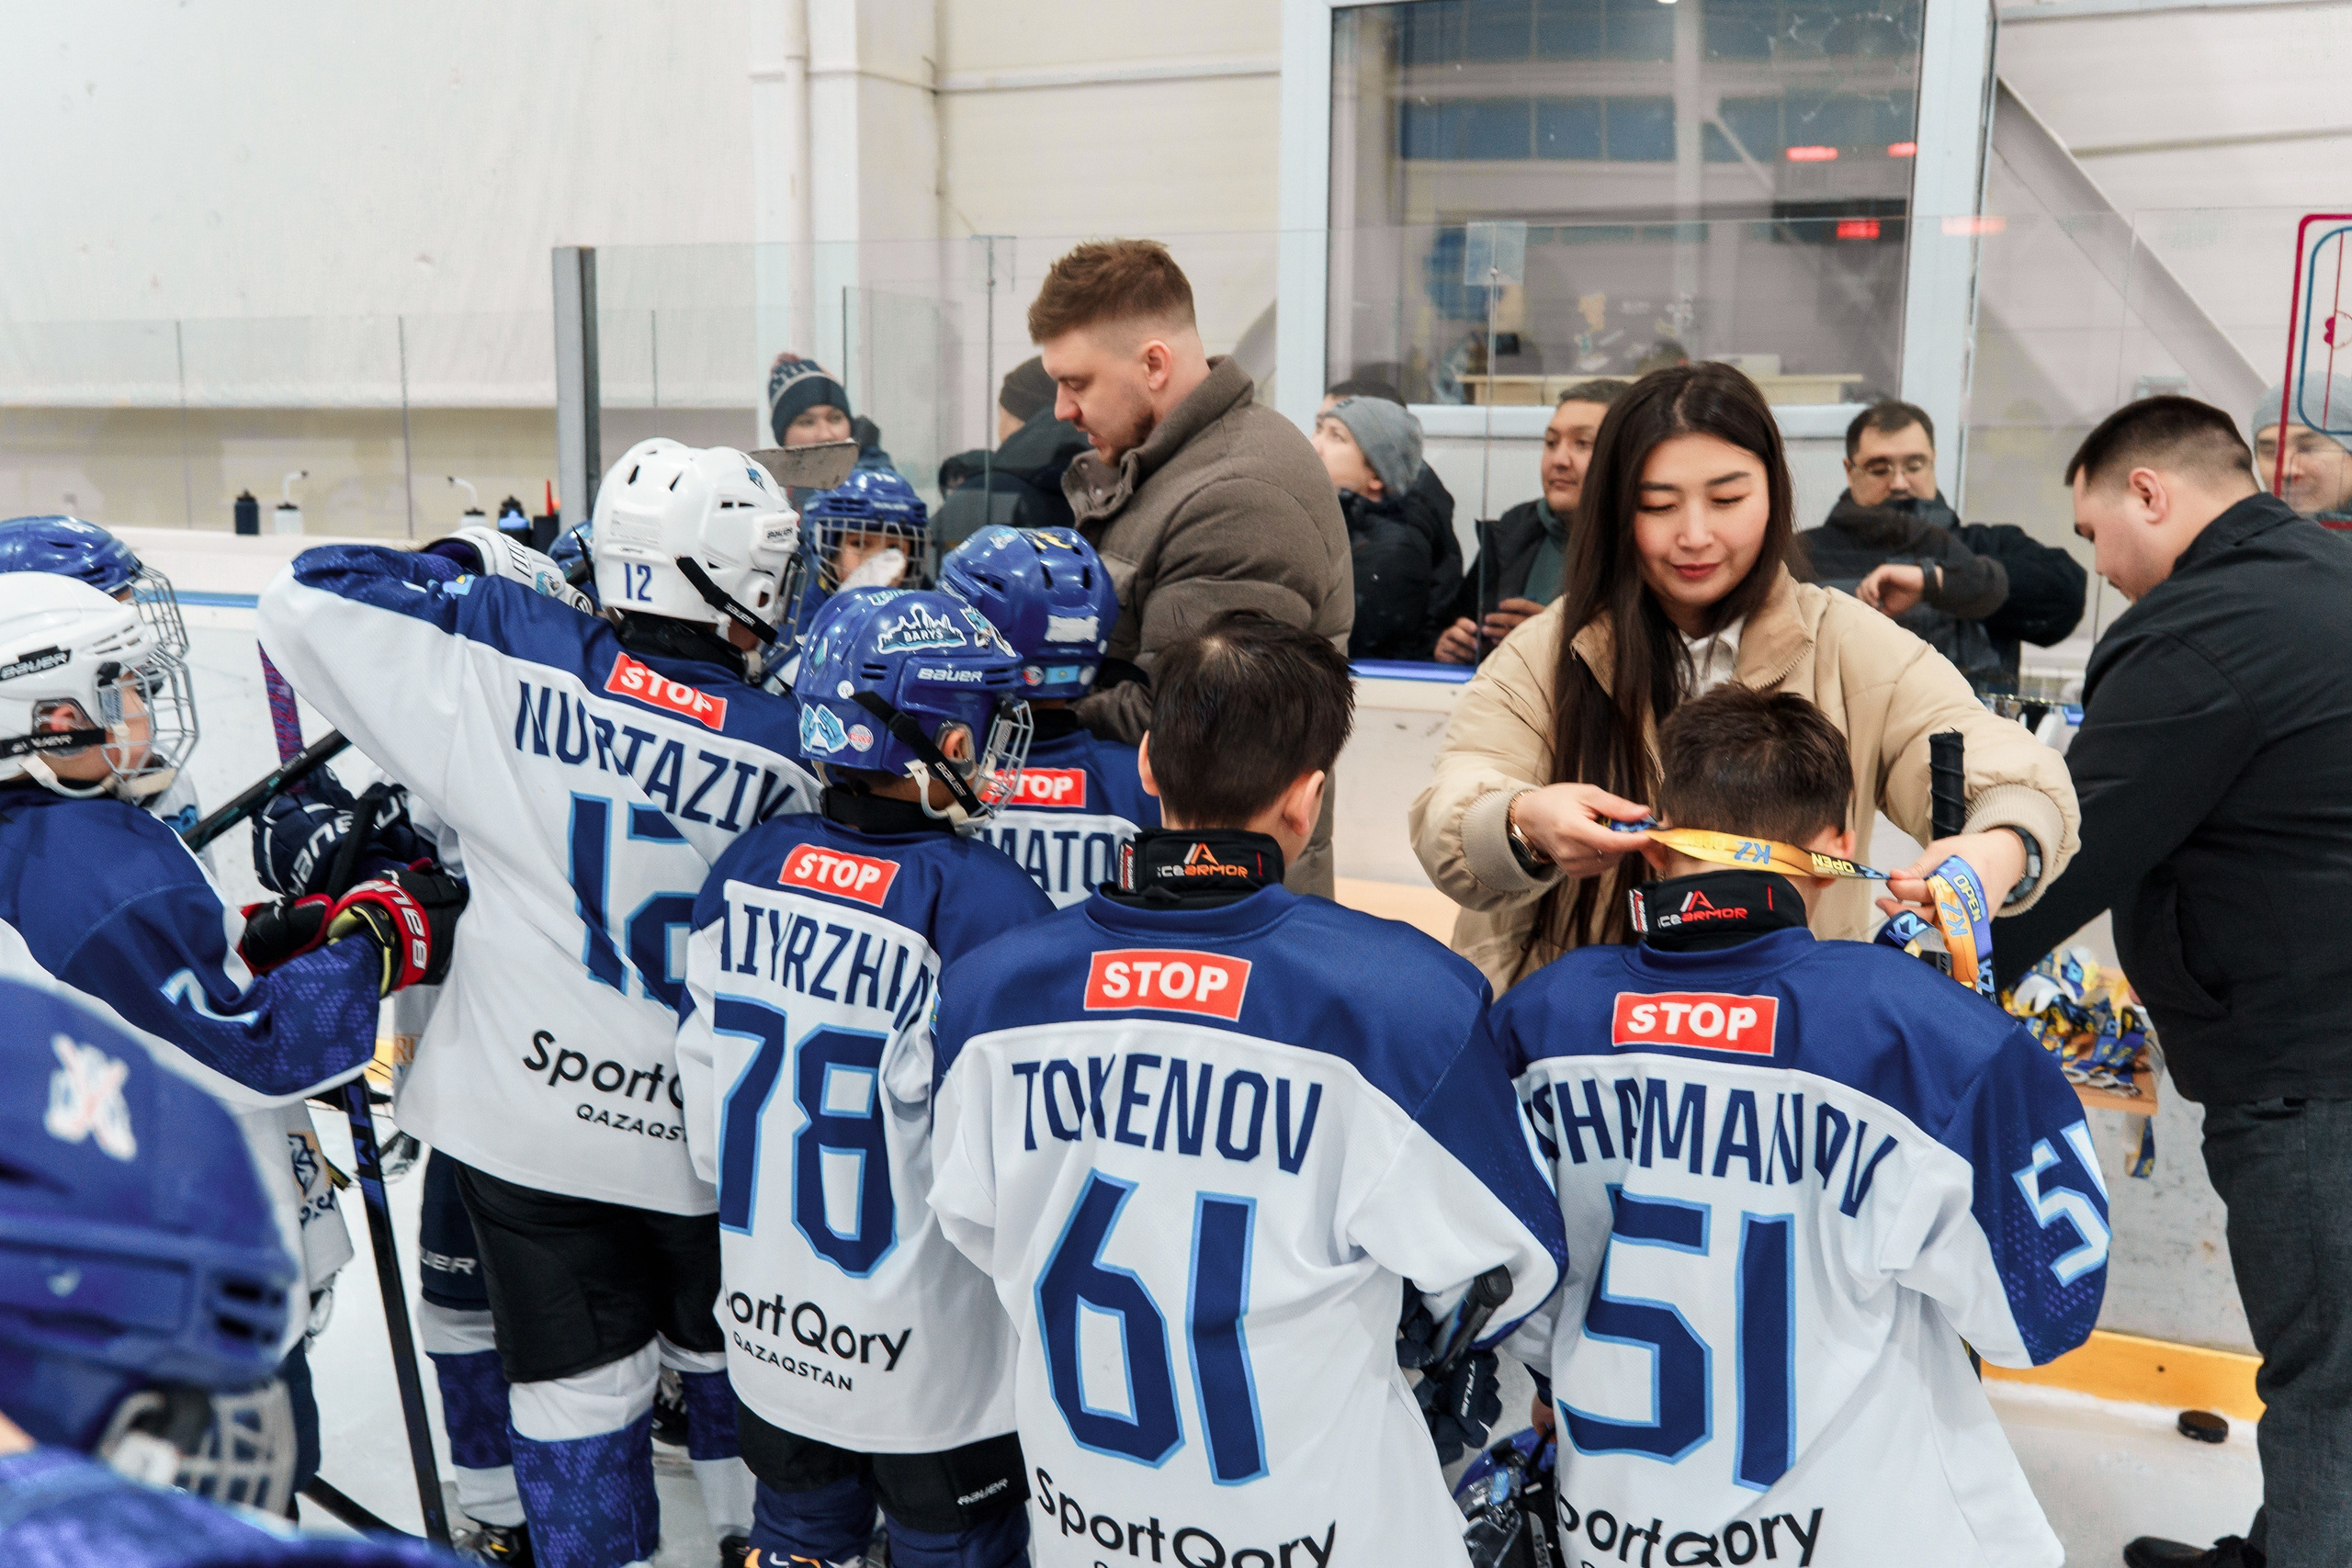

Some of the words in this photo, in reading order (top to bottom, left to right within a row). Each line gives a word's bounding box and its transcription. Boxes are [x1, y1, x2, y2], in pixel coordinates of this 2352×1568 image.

[624, 562, 652, 602] 12
[903, 628, 944, 642] BARYS
[620, 667, 713, 714] STOP
[288, 809, 356, 897] AUER
[795, 853, 882, 892] STOP
[1733, 840, 1771, 865] KZ
[1810, 852, 1856, 874] OPEN
[1939, 899, 1969, 937] KZ
[1952, 874, 1983, 923] OPEN
[1885, 912, 1928, 949] KZ
[1102, 962, 1229, 1002] STOP
[1628, 1002, 1758, 1041] STOP
[522, 1030, 684, 1111] Sport
[577, 1103, 687, 1144] QAZAQS
[713, 990, 899, 1279] 78
[1012, 1053, 1323, 1175] TOKENOV
[726, 1291, 912, 1372] ortQory
[1034, 1167, 1271, 1487] 61
[1555, 1181, 1796, 1494] 51
[733, 1330, 853, 1392] QAZAQSTAN
